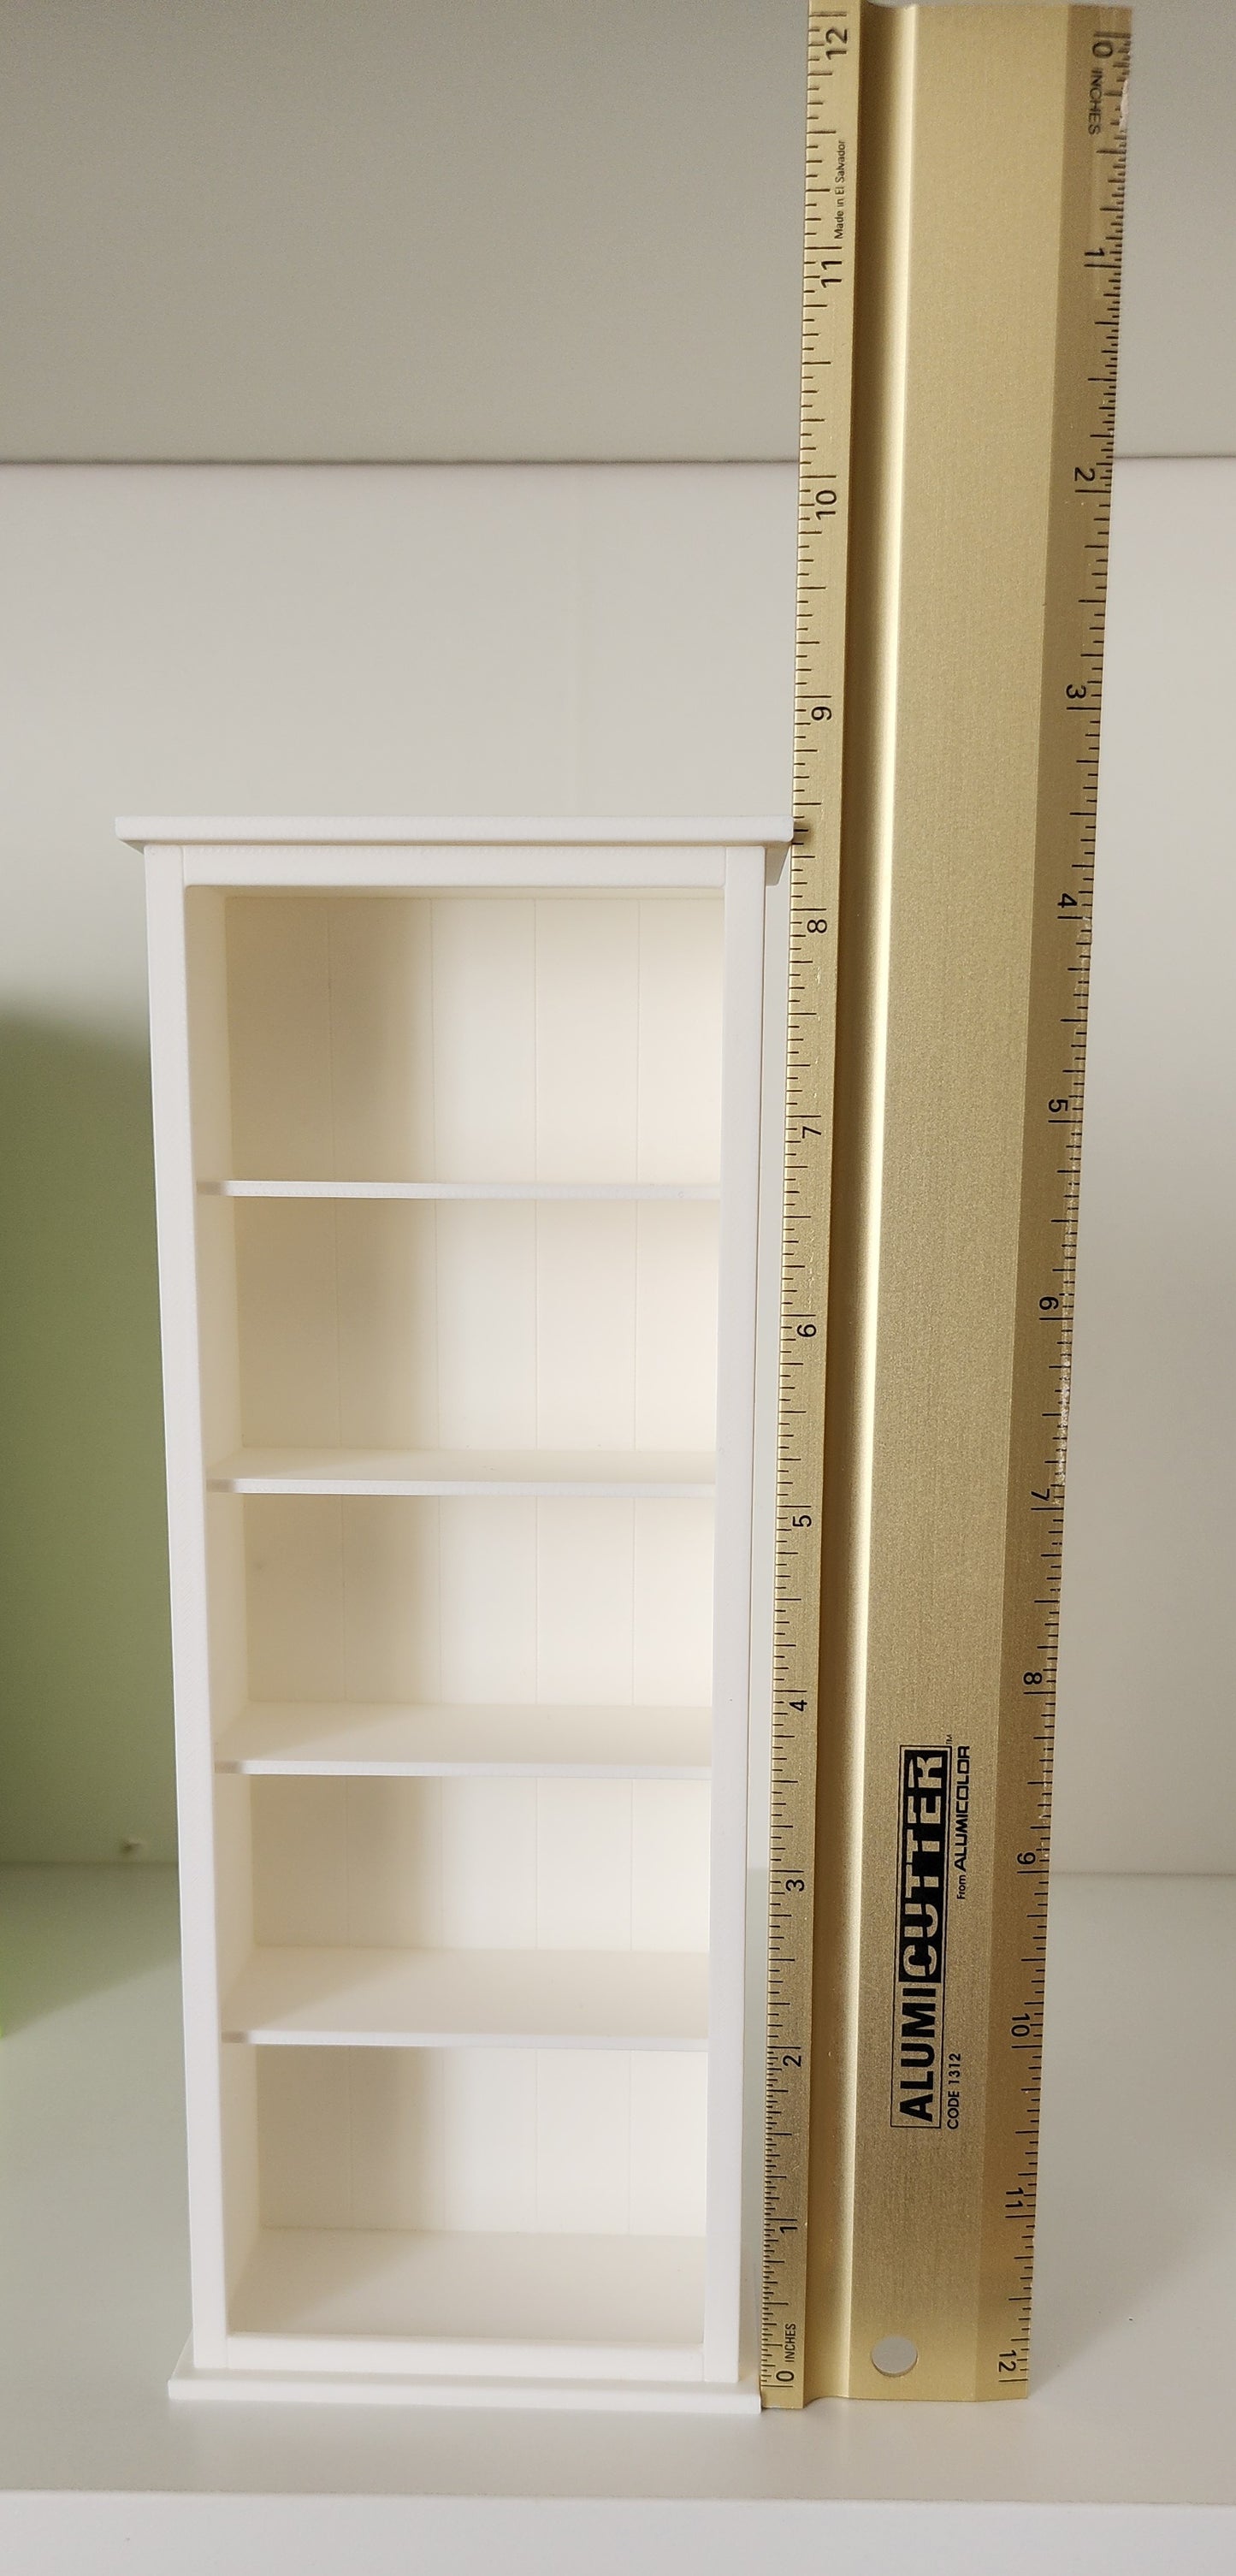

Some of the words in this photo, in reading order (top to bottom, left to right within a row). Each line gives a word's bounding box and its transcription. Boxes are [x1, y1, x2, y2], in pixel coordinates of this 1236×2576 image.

[825, 27, 848, 60] 12
[1091, 41, 1113, 59] 0
[1088, 70, 1103, 136] INCHES
[835, 139, 846, 182] Salvador
[835, 183, 844, 195] El
[837, 197, 844, 208] in
[834, 210, 844, 240] Made
[1084, 247, 1105, 258] 1
[821, 260, 843, 288] 11
[1074, 467, 1096, 483] 2
[815, 489, 837, 520] 10
[1066, 684, 1087, 699] 3
[811, 706, 832, 721] 9
[1057, 892, 1078, 909] 4
[807, 918, 827, 934] 8
[1048, 1099, 1068, 1113] 5
[801, 1125, 822, 1139] 7
[1038, 1296, 1059, 1311] 6
[796, 1324, 817, 1338] 6
[1031, 1488, 1051, 1501] 7
[792, 1514, 813, 1528] 5
[1023, 1672, 1044, 1685] 8
[789, 1699, 808, 1712] 4
[953, 1745, 971, 1871] ALUMICOLOR
[1016, 1851, 1037, 1865] 9
[785, 1879, 805, 1892] 3
[956, 1874, 967, 1900] From
[1011, 2012, 1031, 2037] 10
[783, 2054, 801, 2068] 2
[948, 2053, 962, 2085] 1312
[948, 2090, 961, 2130] CODE
[1005, 2187, 1025, 2208] 11
[779, 2225, 798, 2234] 1
[784, 2323, 797, 2363] INCHES
[998, 2349, 1017, 2373] 12
[776, 2370, 795, 2384] 0
